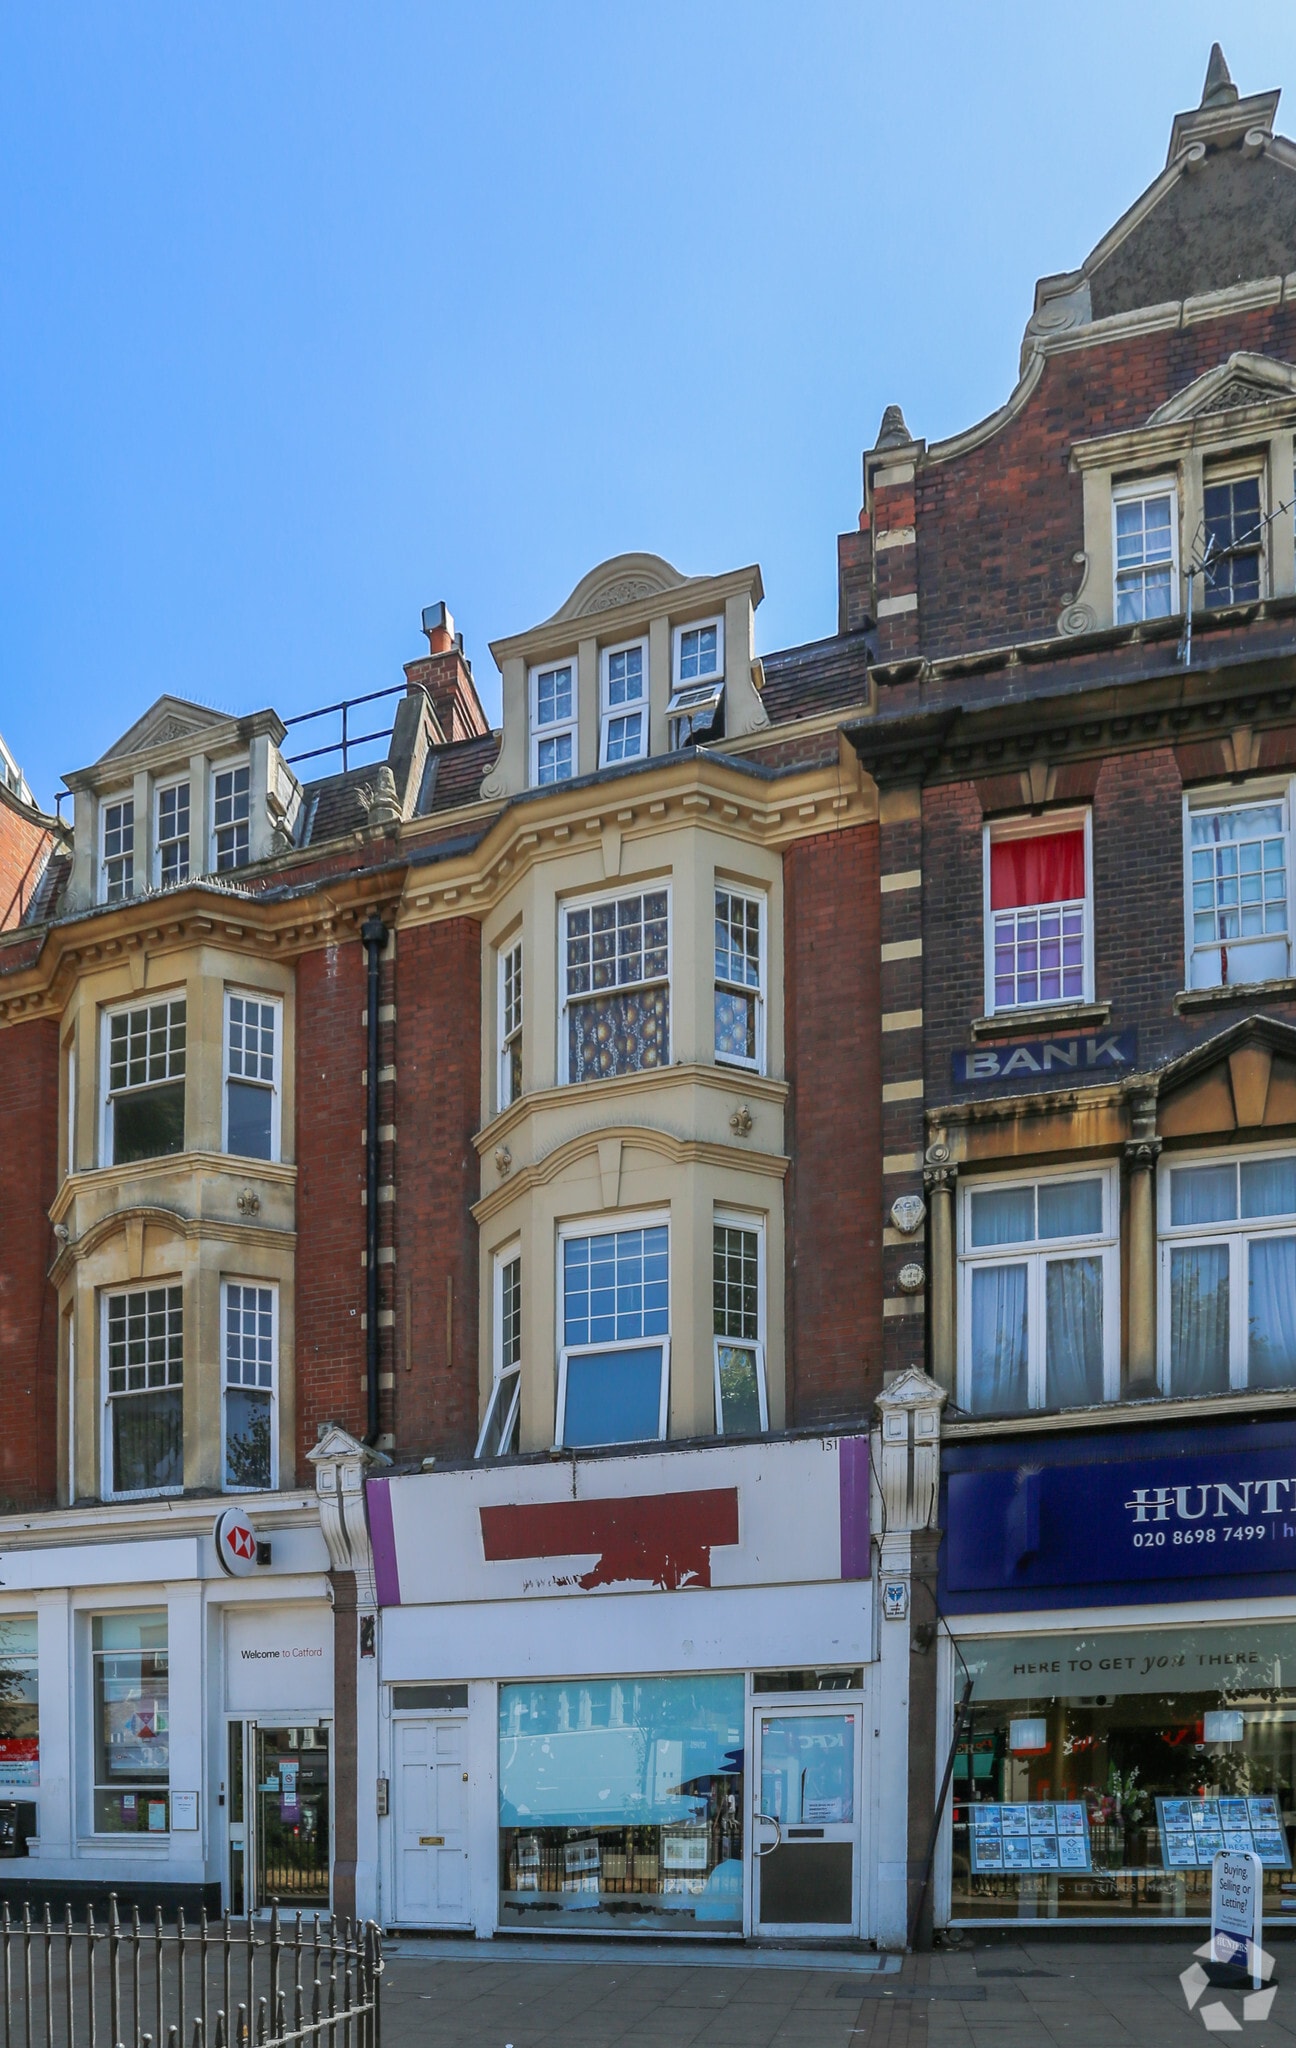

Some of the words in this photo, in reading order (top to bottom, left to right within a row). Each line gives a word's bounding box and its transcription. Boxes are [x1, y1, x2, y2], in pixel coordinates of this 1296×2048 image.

[965, 1035, 1126, 1079] BANK
[821, 1440, 838, 1451] 151
[1125, 1479, 1296, 1522] HUNT
[1133, 1532, 1166, 1547] 020
[1172, 1528, 1216, 1545] 8698
[1223, 1525, 1266, 1542] 7499
[241, 1650, 280, 1659] Welcome
[282, 1650, 290, 1658] to
[292, 1648, 322, 1657] Catford
[1013, 1660, 1061, 1675] HERE
[1068, 1659, 1093, 1672] TO
[1099, 1657, 1136, 1670] GET
[1140, 1654, 1186, 1675] you
[1196, 1651, 1258, 1665] THERE
[1223, 1862, 1248, 1880] Buying,
[1219, 1878, 1240, 1896] Selling
[1242, 1885, 1251, 1894] or
[1221, 1895, 1248, 1914] Letting?
[1216, 1936, 1248, 1952] HUNTERS
